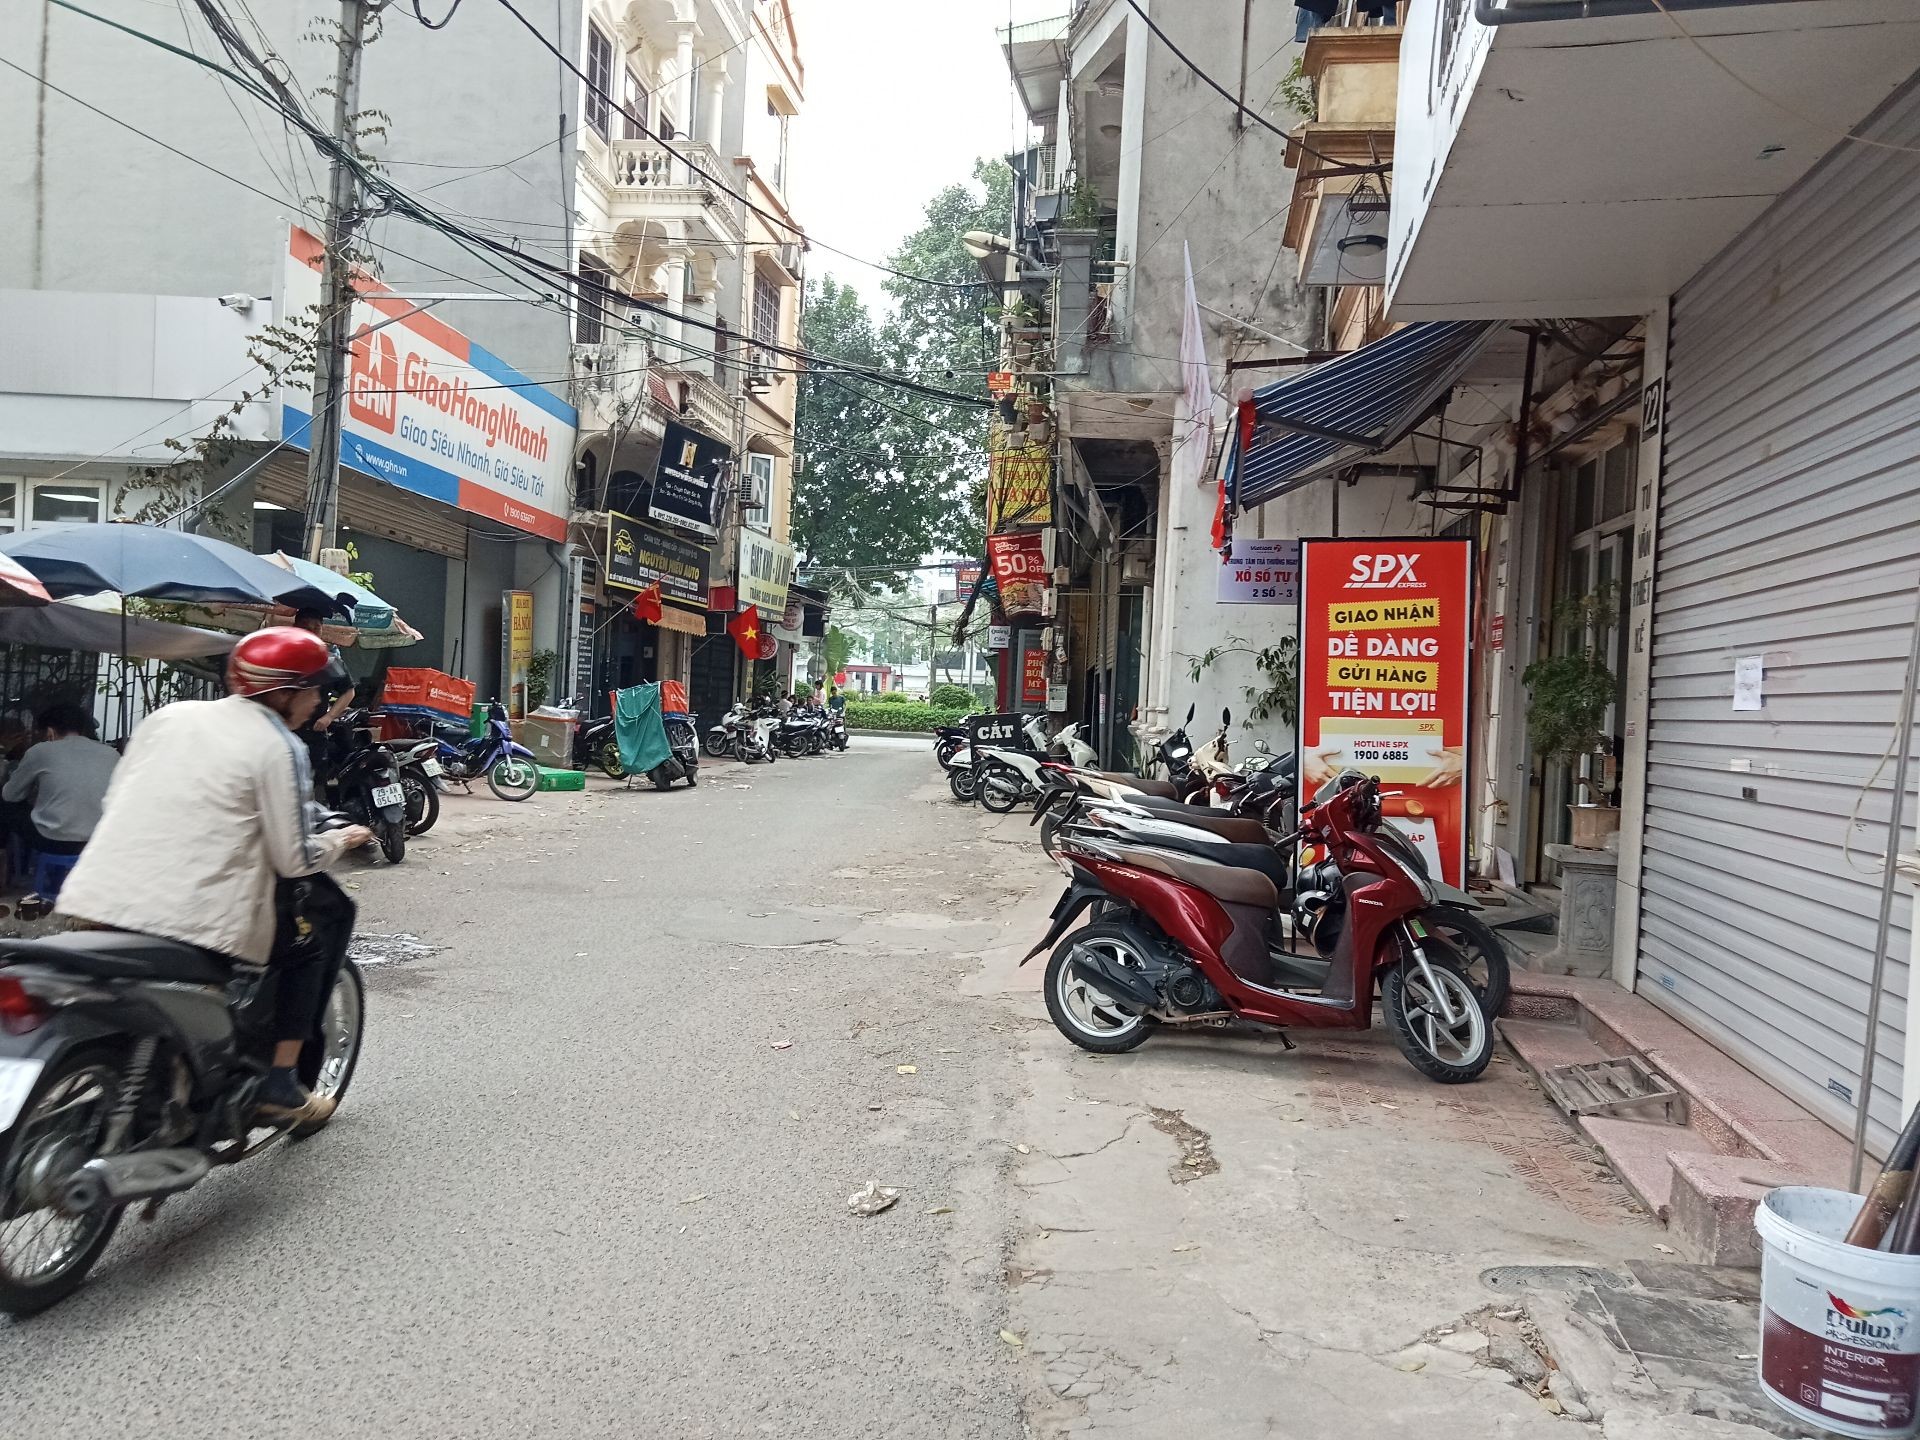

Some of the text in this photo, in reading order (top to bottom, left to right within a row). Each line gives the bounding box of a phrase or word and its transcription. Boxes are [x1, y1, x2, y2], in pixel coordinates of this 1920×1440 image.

[353, 371, 393, 419] GHN
[403, 351, 548, 462] GiaoHangNhanh
[1644, 385, 1659, 433] 22
[365, 452, 408, 477] www.ghn.vn
[400, 415, 428, 447] Giao
[430, 429, 455, 458] Siêu
[494, 458, 510, 482] Giá
[511, 466, 529, 491] Siêu
[532, 474, 545, 497] Tốt
[996, 553, 1039, 576] 50 %
[1235, 566, 1252, 583] XỔ
[1255, 567, 1271, 583] SỐ
[1349, 553, 1421, 582] SPX
[1252, 588, 1259, 598] 2
[1261, 585, 1276, 598] SỐ
[1286, 588, 1293, 598] 3
[1334, 604, 1434, 624] GIAO NHẬN
[1327, 631, 1439, 657] DỄ DÀNG
[1338, 663, 1427, 683] GỬI HÀNG
[1328, 687, 1436, 716] TIỆN LỢI!
[977, 720, 1014, 740] CẮT
[1419, 723, 1435, 731] SPX
[1353, 740, 1409, 749] HOTLINE SPX
[1354, 750, 1409, 761] 1900 6885
[1407, 832, 1425, 843] ẬP
[1358, 898, 1384, 907] HONDA
[1825, 1328, 1902, 1352] PROFESSIONAL
[1823, 1344, 1887, 1367] INTERIOR
[1823, 1356, 1849, 1369] A390
